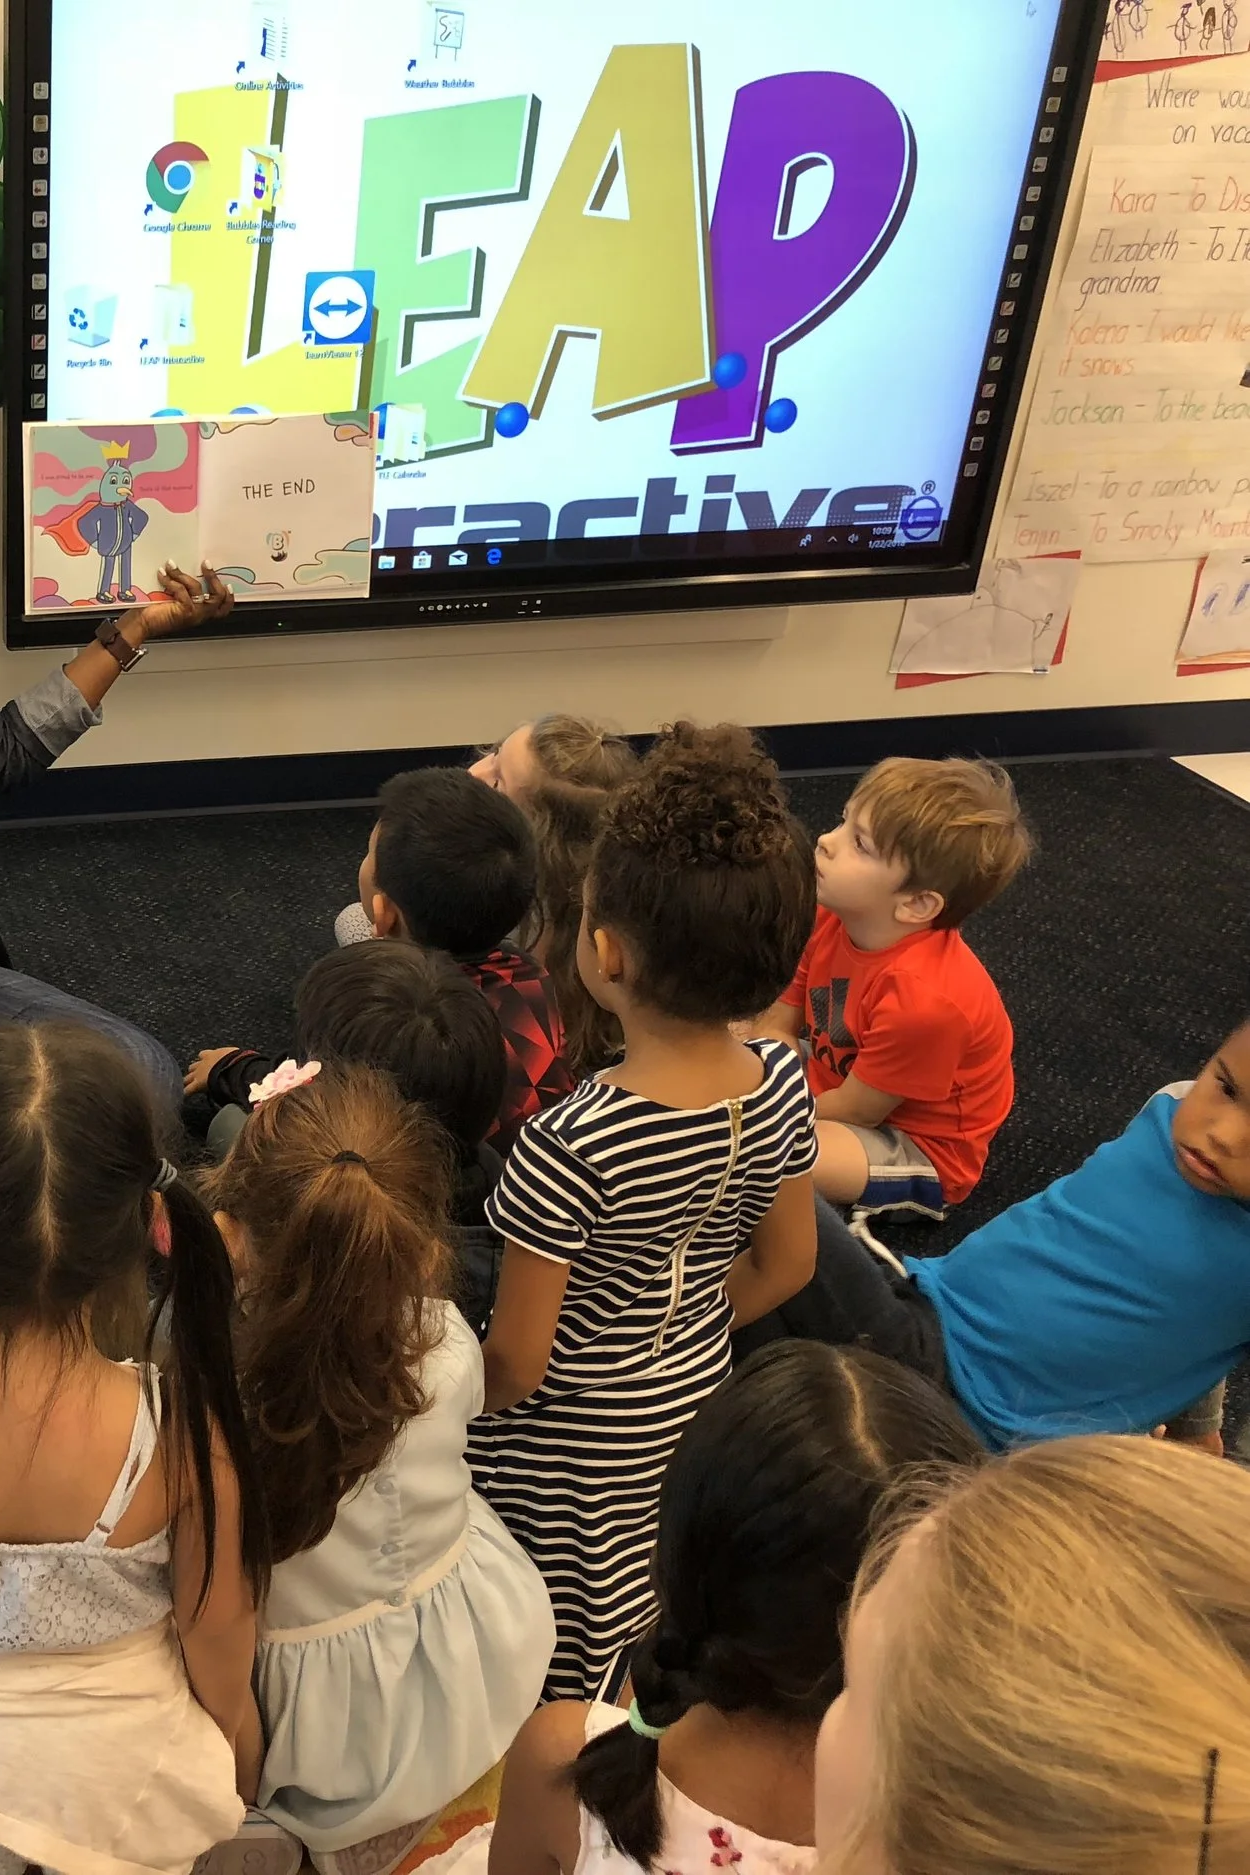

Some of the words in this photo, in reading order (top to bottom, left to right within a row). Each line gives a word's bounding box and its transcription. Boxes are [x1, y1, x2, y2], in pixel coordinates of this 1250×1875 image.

[235, 81, 263, 92] Online
[1146, 72, 1199, 108] Where
[1172, 125, 1196, 145] on
[1110, 177, 1157, 213] Kara
[143, 222, 175, 233] Google
[177, 222, 211, 232] Chrome
[166, 43, 918, 466] LEAP
[1089, 226, 1179, 263] Elizabeth
[1206, 226, 1226, 261] To
[242, 483, 273, 500] THE
[283, 478, 315, 496] END
